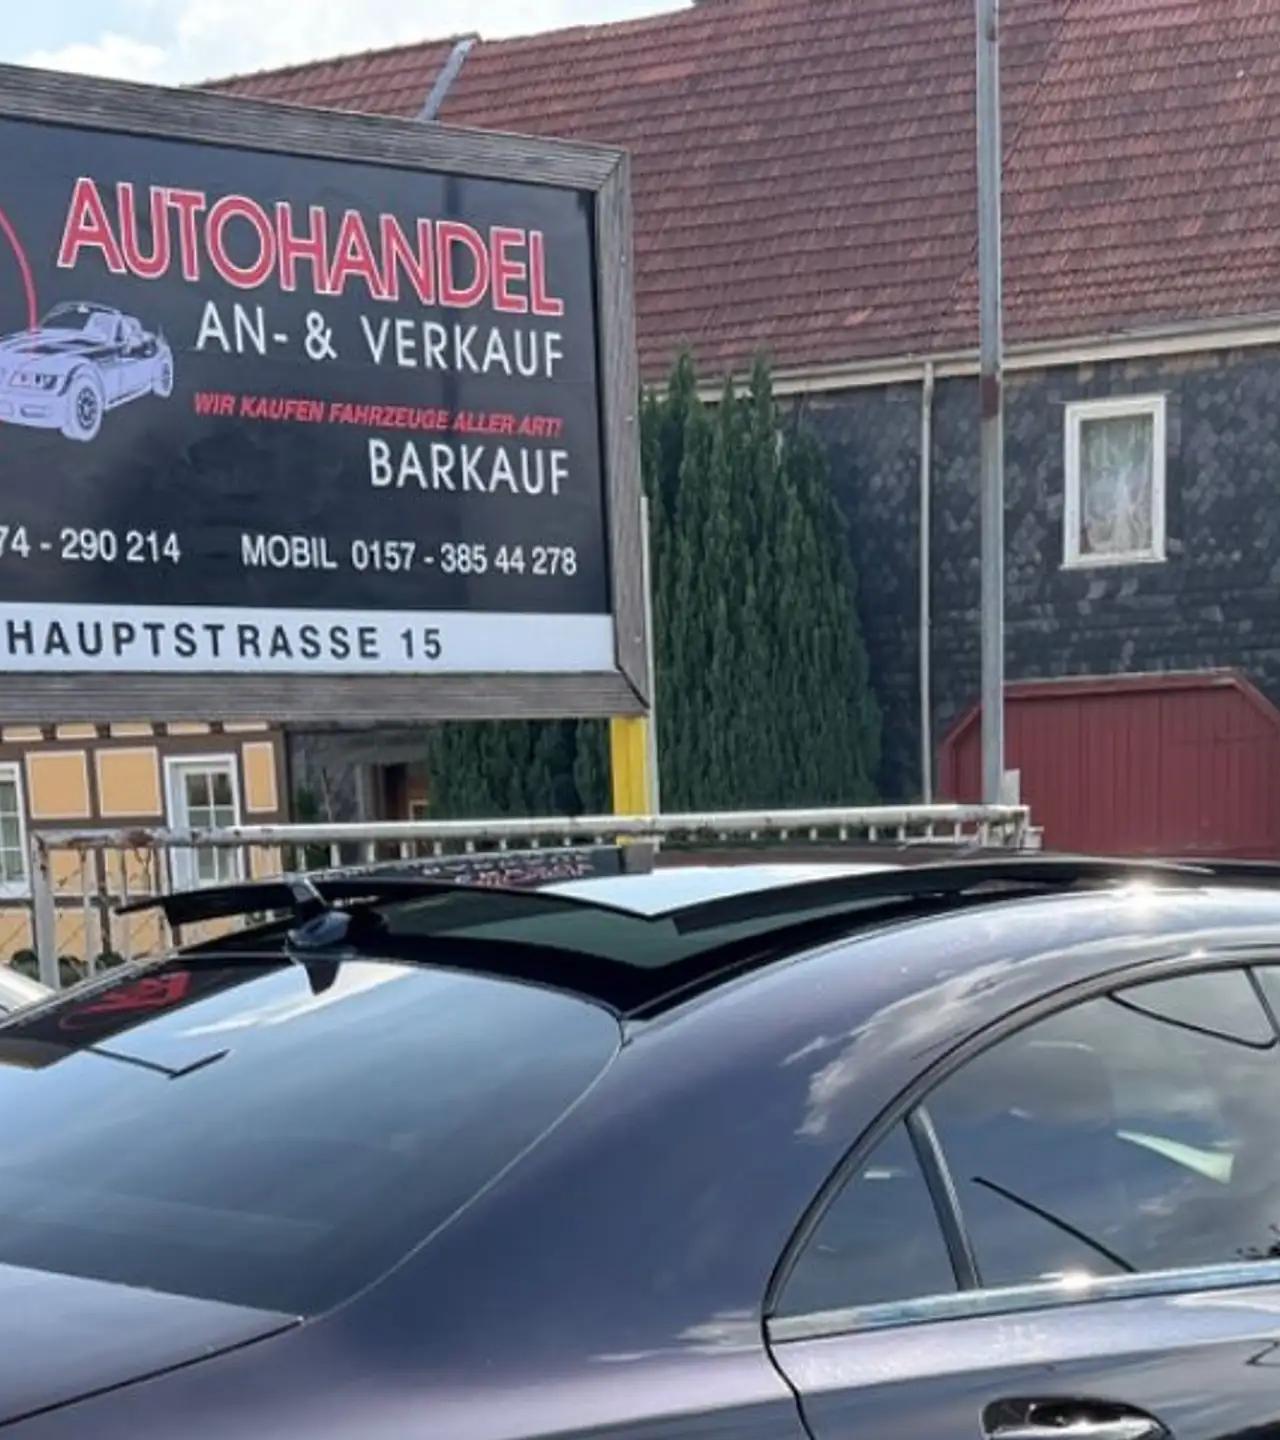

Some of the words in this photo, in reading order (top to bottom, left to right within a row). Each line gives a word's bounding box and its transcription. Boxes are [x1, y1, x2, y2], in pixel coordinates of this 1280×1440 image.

[57, 176, 564, 316] AUTOHANDEL
[195, 300, 289, 356] AN-
[305, 310, 338, 361] &
[360, 315, 564, 378] VERKAUF
[194, 391, 234, 417] WIR
[240, 394, 325, 424] KAUFEN
[328, 402, 450, 432] FAHRZEUGE
[453, 411, 515, 435] ALLER
[518, 415, 564, 438] ART!
[368, 438, 569, 496] BARKAUF
[60, 528, 118, 562] 290
[125, 530, 181, 564] 214
[241, 533, 338, 570] MOBIL
[351, 540, 416, 572] 0157
[440, 543, 488, 574] 385
[494, 546, 525, 575] 44
[531, 546, 577, 577] 278
[6, 620, 380, 661] HAUPTSTRASSE
[400, 628, 443, 661] 15
